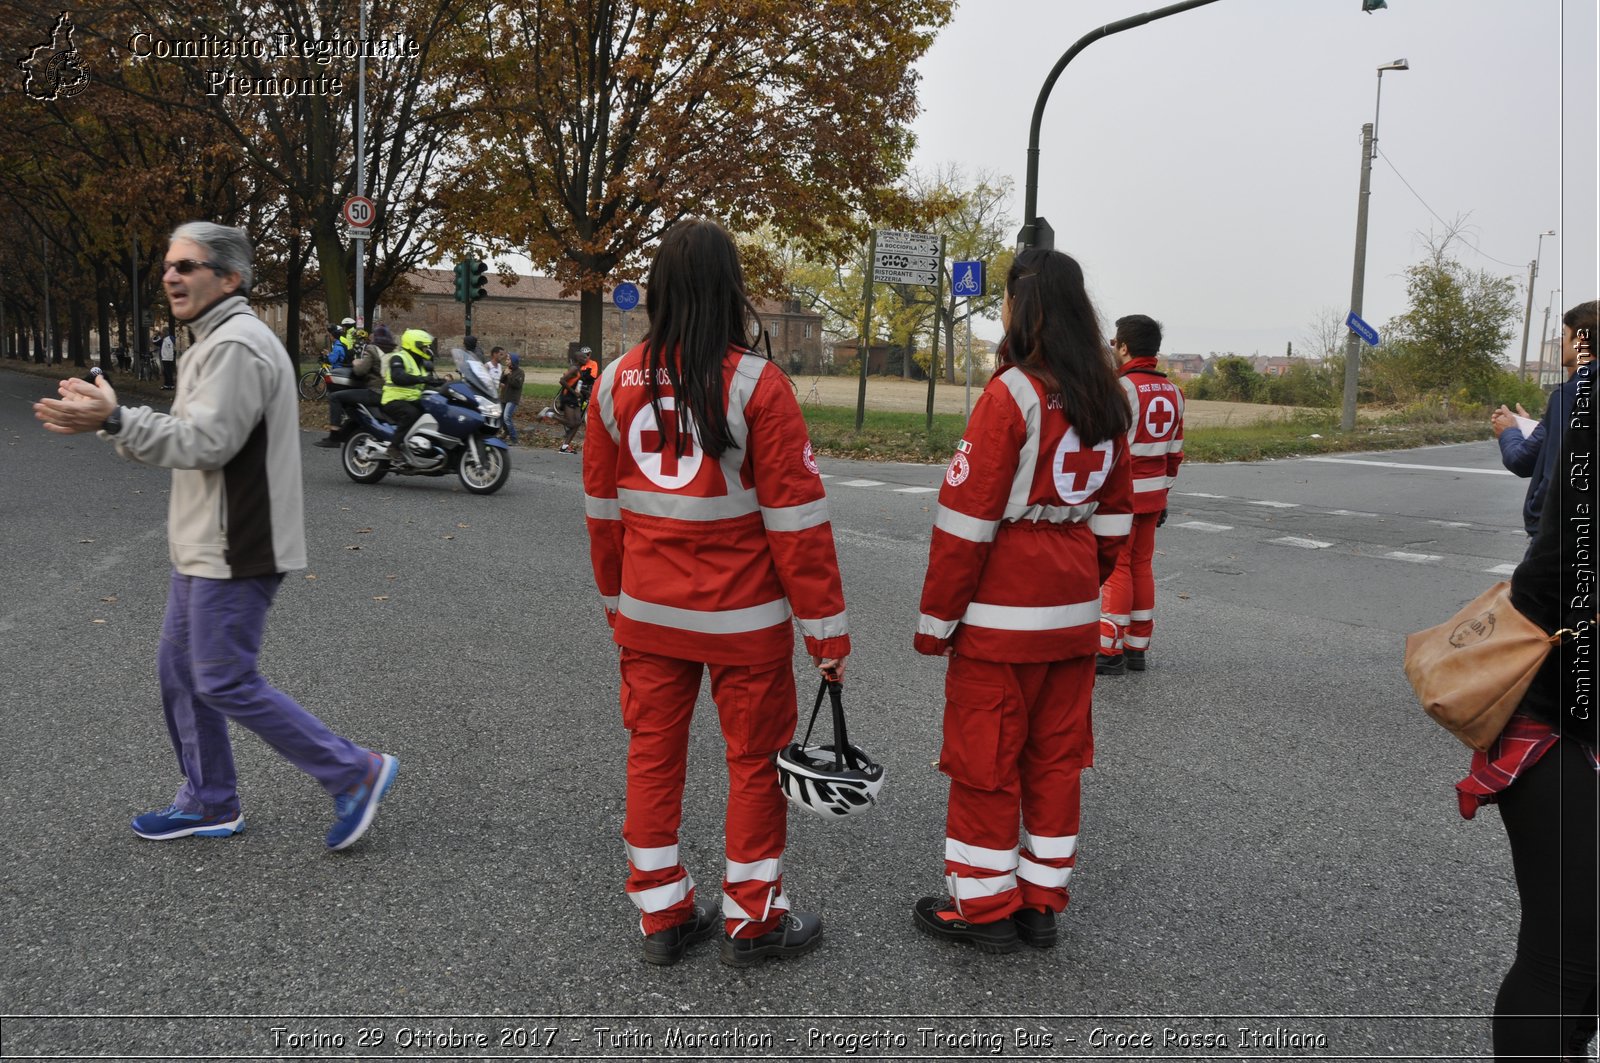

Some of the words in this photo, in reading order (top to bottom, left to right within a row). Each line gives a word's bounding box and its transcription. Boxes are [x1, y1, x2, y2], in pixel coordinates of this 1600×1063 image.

[352, 204, 368, 219] 50
[884, 243, 918, 251] BOCCIOFILA
[874, 269, 913, 278] RISTORANTE
